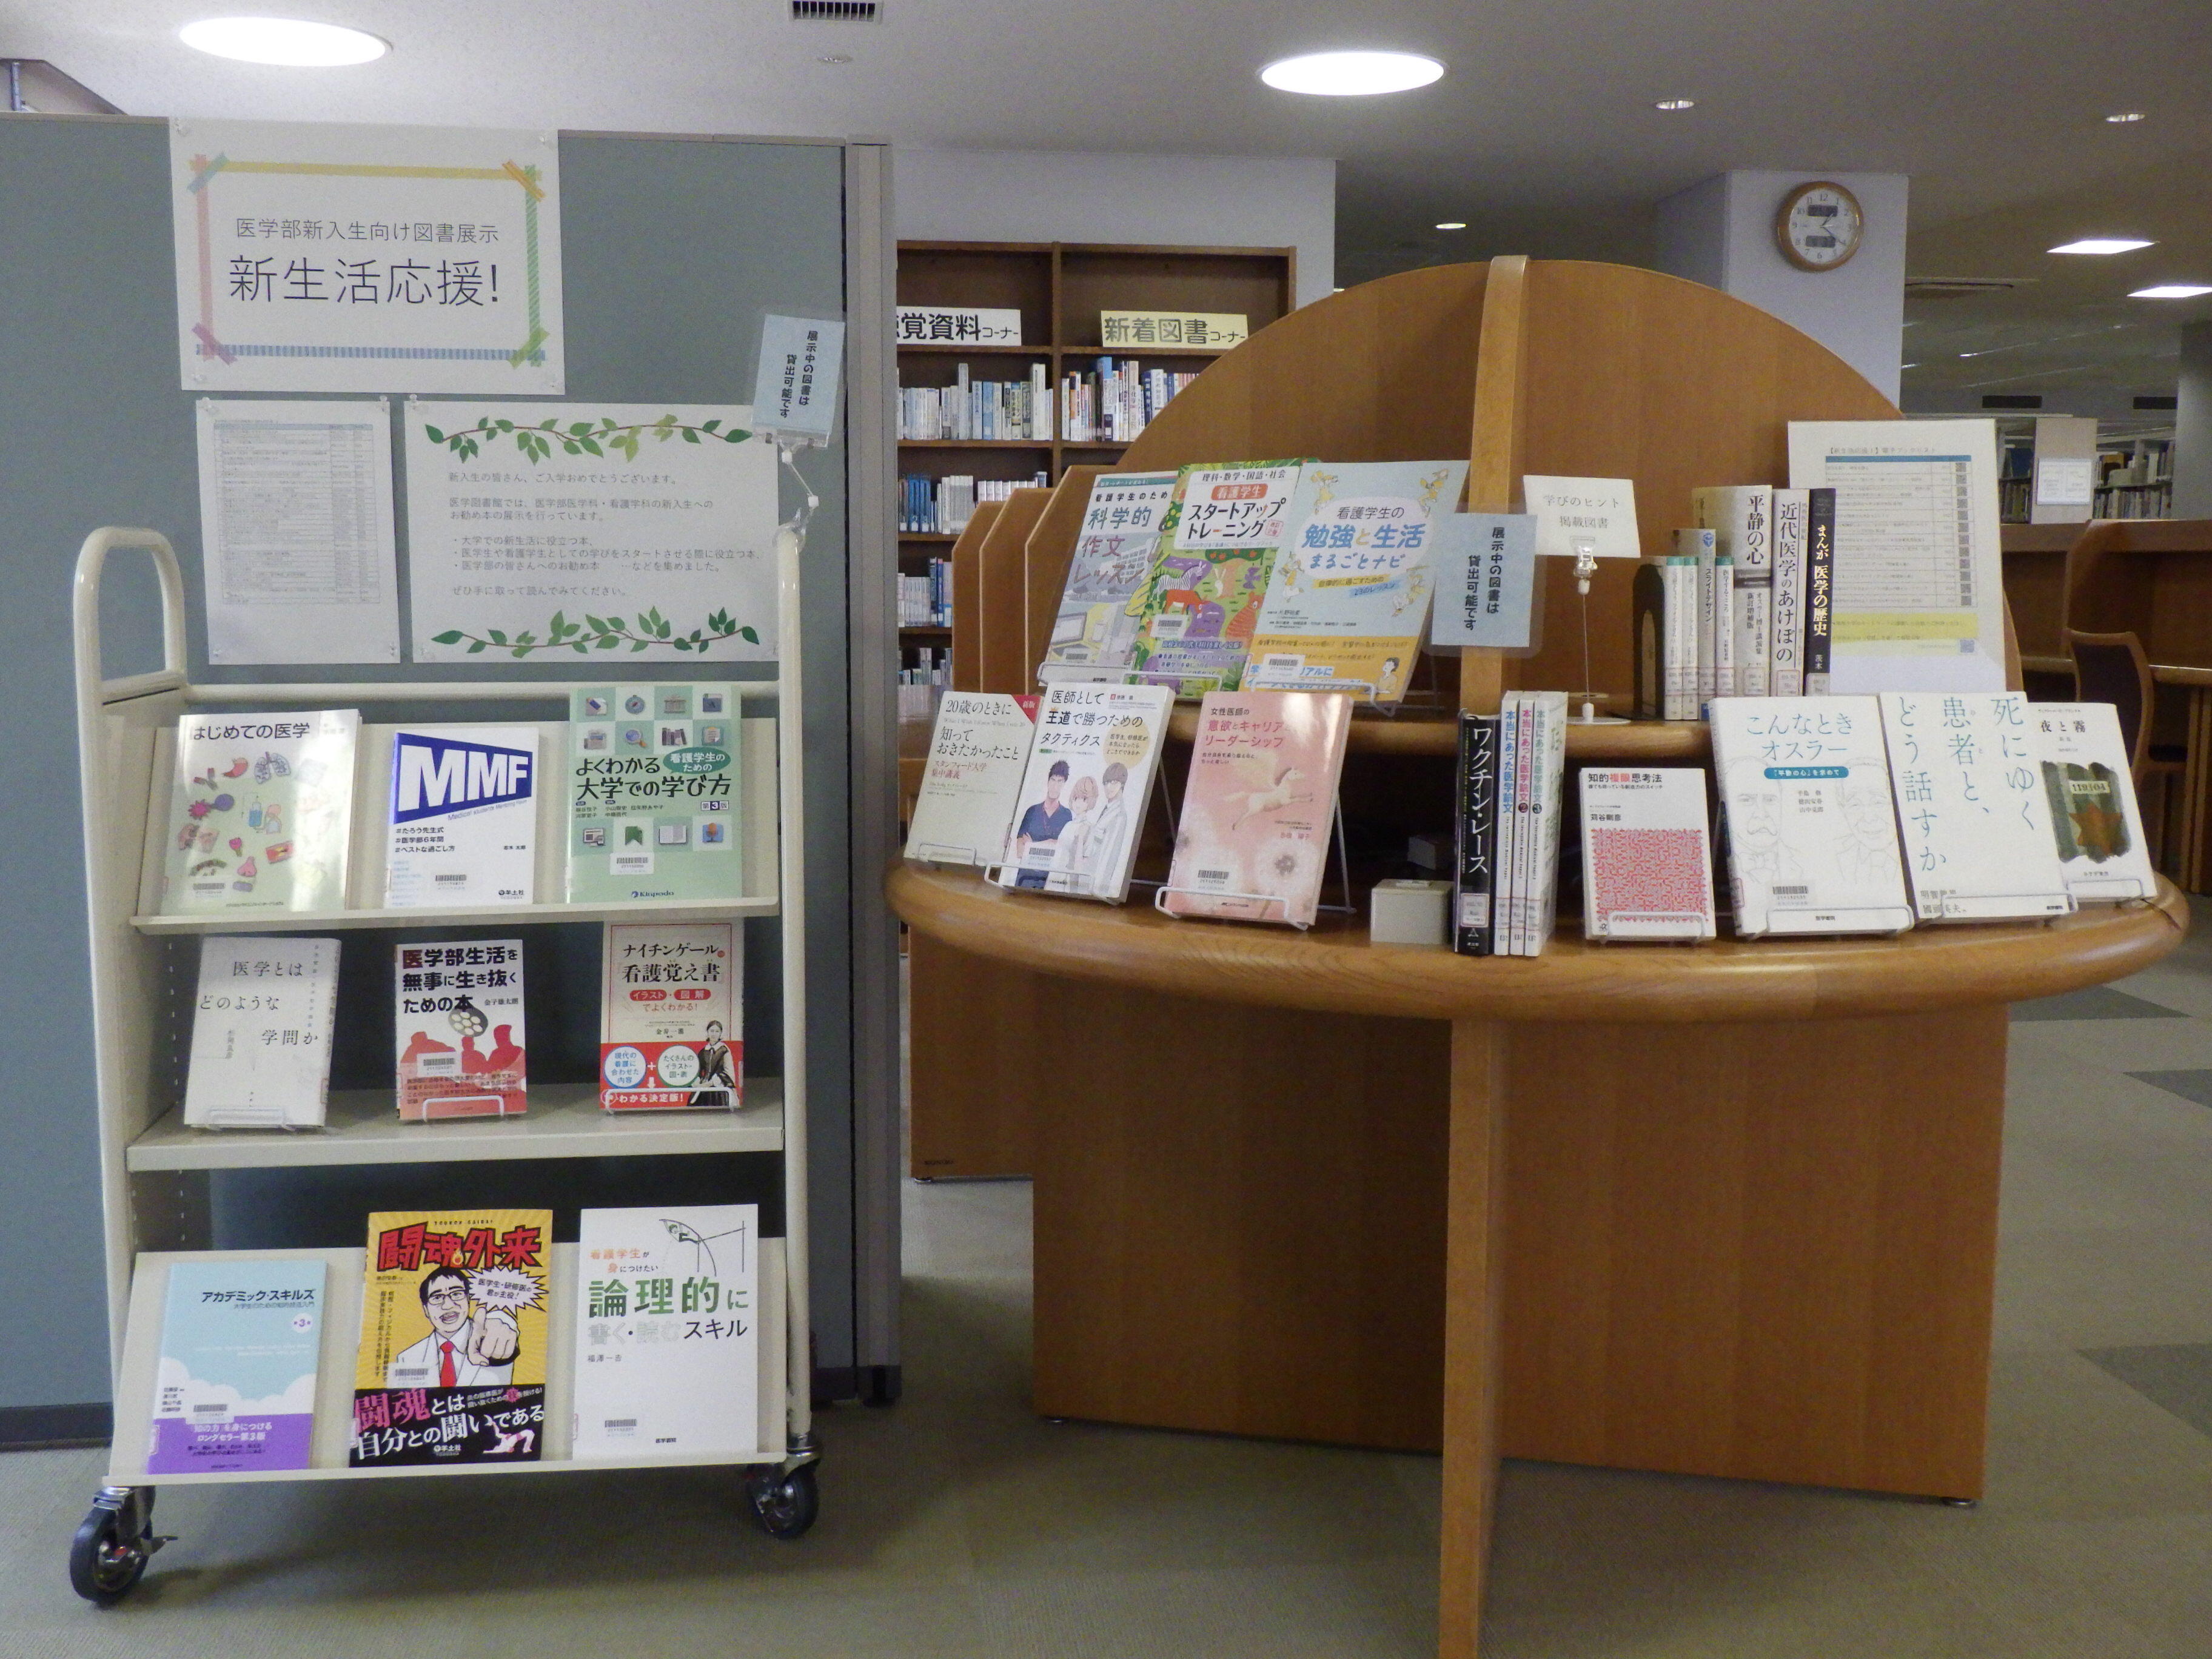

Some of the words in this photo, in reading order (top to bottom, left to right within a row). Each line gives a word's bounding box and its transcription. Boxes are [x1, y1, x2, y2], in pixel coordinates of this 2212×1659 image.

[236, 218, 499, 243] 医学部新入生向け図書展示
[896, 313, 1019, 341] 覚資料コーナー
[1104, 317, 1245, 344] 新着図書コーナー
[799, 330, 818, 406] 展示中の図書は
[780, 354, 797, 418] 貸出可能です
[1202, 470, 1285, 482] 理科・数学・国語・社会
[1217, 486, 1262, 500] 看護学生
[1544, 495, 1620, 508] 学びのヒント
[1088, 506, 1151, 529] 科学的
[1188, 497, 1287, 520] スタートアップ
[1337, 506, 1405, 520] 看護学生の
[1188, 520, 1266, 540] トレーニング
[1560, 516, 1609, 529] 掲載図書
[1746, 494, 1765, 565] 平静の心
[1082, 535, 1125, 557] 作文
[1301, 523, 1426, 549] 勉強と生活
[1816, 525, 1829, 560] まんが
[1310, 554, 1406, 569] まるごとナビ
[1487, 527, 1505, 614] 展示中の図書は
[1074, 564, 1145, 585] レッスン
[1777, 503, 1797, 662] 近代医学のあけぼの
[1464, 555, 1481, 630] 貸出可能です
[1814, 565, 1829, 636] 医学の歴史
[946, 699, 1012, 716] 20歳のときに
[1051, 690, 1104, 705] 医師として
[1045, 710, 1143, 728] 王道で勝つための
[1207, 720, 1284, 732] 意欲とキャリア
[1746, 713, 1854, 736] こんなとき
[193, 723, 310, 740] はじめての医学
[940, 726, 973, 742] 知って
[1041, 732, 1101, 746] タクティクス
[1205, 735, 1284, 748] リーダーシップ
[671, 752, 725, 762] 看護学生の
[937, 743, 1019, 760] おきたかったこと
[1761, 740, 1847, 760] オスラー
[576, 758, 660, 776] よくわかる
[1991, 697, 2034, 830] 死にゆく
[398, 745, 528, 811] MMF
[577, 774, 731, 800] 大学での学び方
[1588, 773, 1663, 783] 知的複眼思考法
[1899, 696, 1946, 871] どう話すか
[1469, 727, 1493, 874] ワクチン・レース
[403, 946, 517, 969] 医学部生活を
[623, 942, 719, 958] ナイチンゲール
[233, 961, 303, 976] 医学とは
[622, 963, 721, 984] 看護覚え書
[403, 970, 517, 992] 無事に生き抜く
[200, 996, 279, 1010] どのような
[404, 994, 473, 1014] ための本
[261, 1030, 318, 1045] 学問か
[377, 1221, 542, 1272] 闘魂外来
[591, 1247, 649, 1259] 看護学生が
[608, 1263, 658, 1273] 身につけたい
[202, 1289, 316, 1303] アカデミック・スキルズ
[589, 1276, 749, 1318] 論理的に
[588, 1319, 748, 1346] 書く・読むスキル
[355, 1388, 464, 1433] 闘魂とは
[358, 1404, 545, 1460] 自分との闘いである
